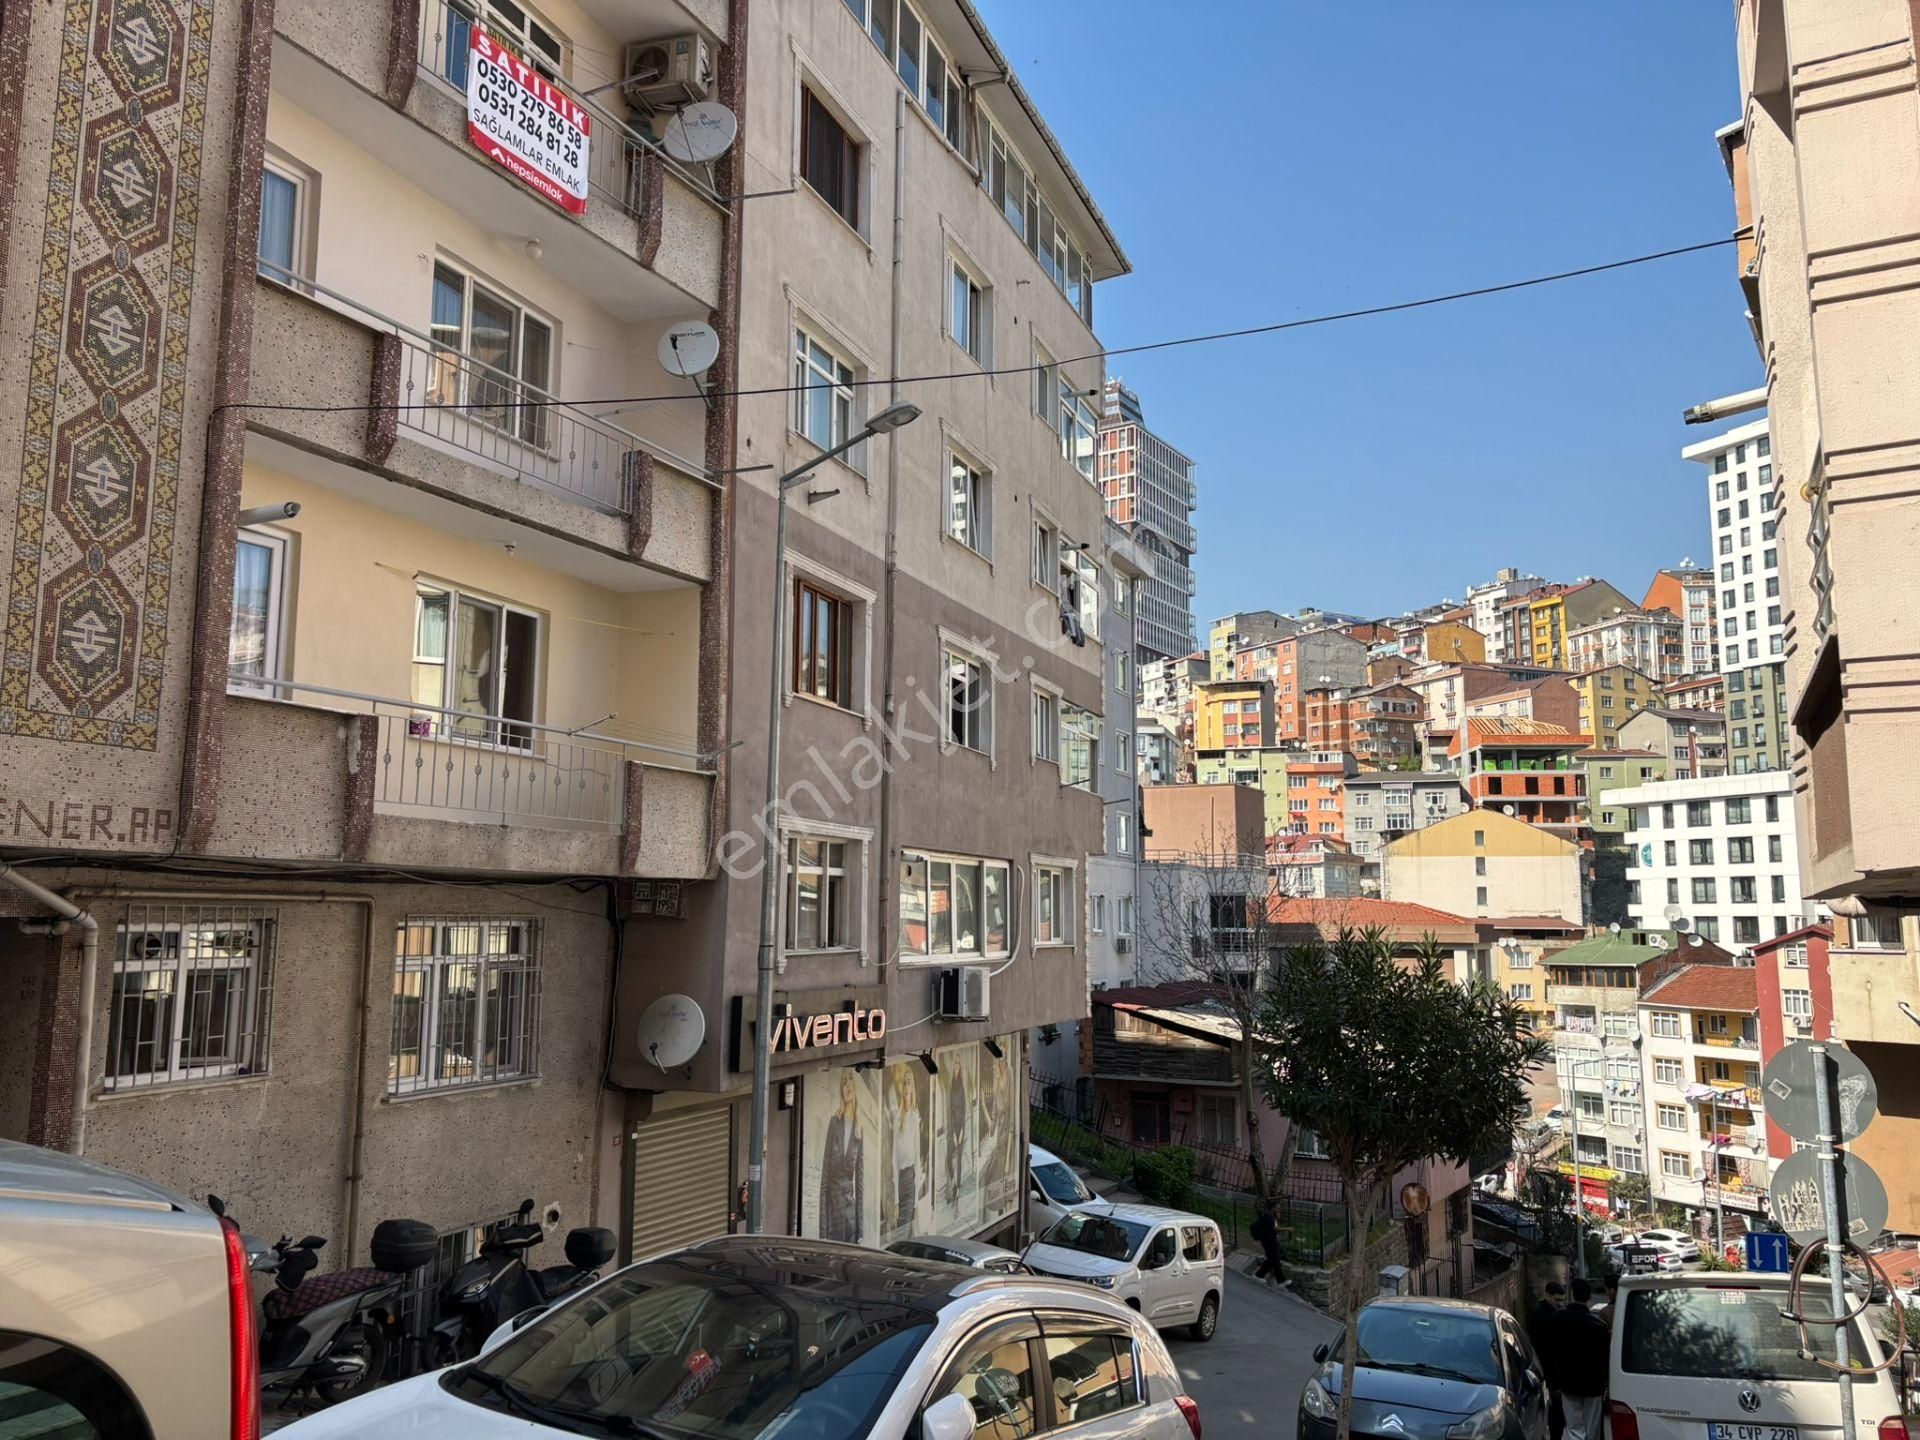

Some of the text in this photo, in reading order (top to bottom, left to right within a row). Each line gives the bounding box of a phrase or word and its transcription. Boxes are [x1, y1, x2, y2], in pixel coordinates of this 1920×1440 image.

[477, 58, 582, 150] 0530 279 86 58
[478, 34, 586, 131] SATILIK
[473, 108, 581, 193] SAĞLAMLAR EMLAK
[478, 83, 579, 169] 0531 284 81 28
[506, 155, 563, 202] hepsiemlak
[769, 1000, 886, 1054] vivento
[1716, 1424, 1733, 1439] 34
[1738, 1426, 1762, 1440] CVP
